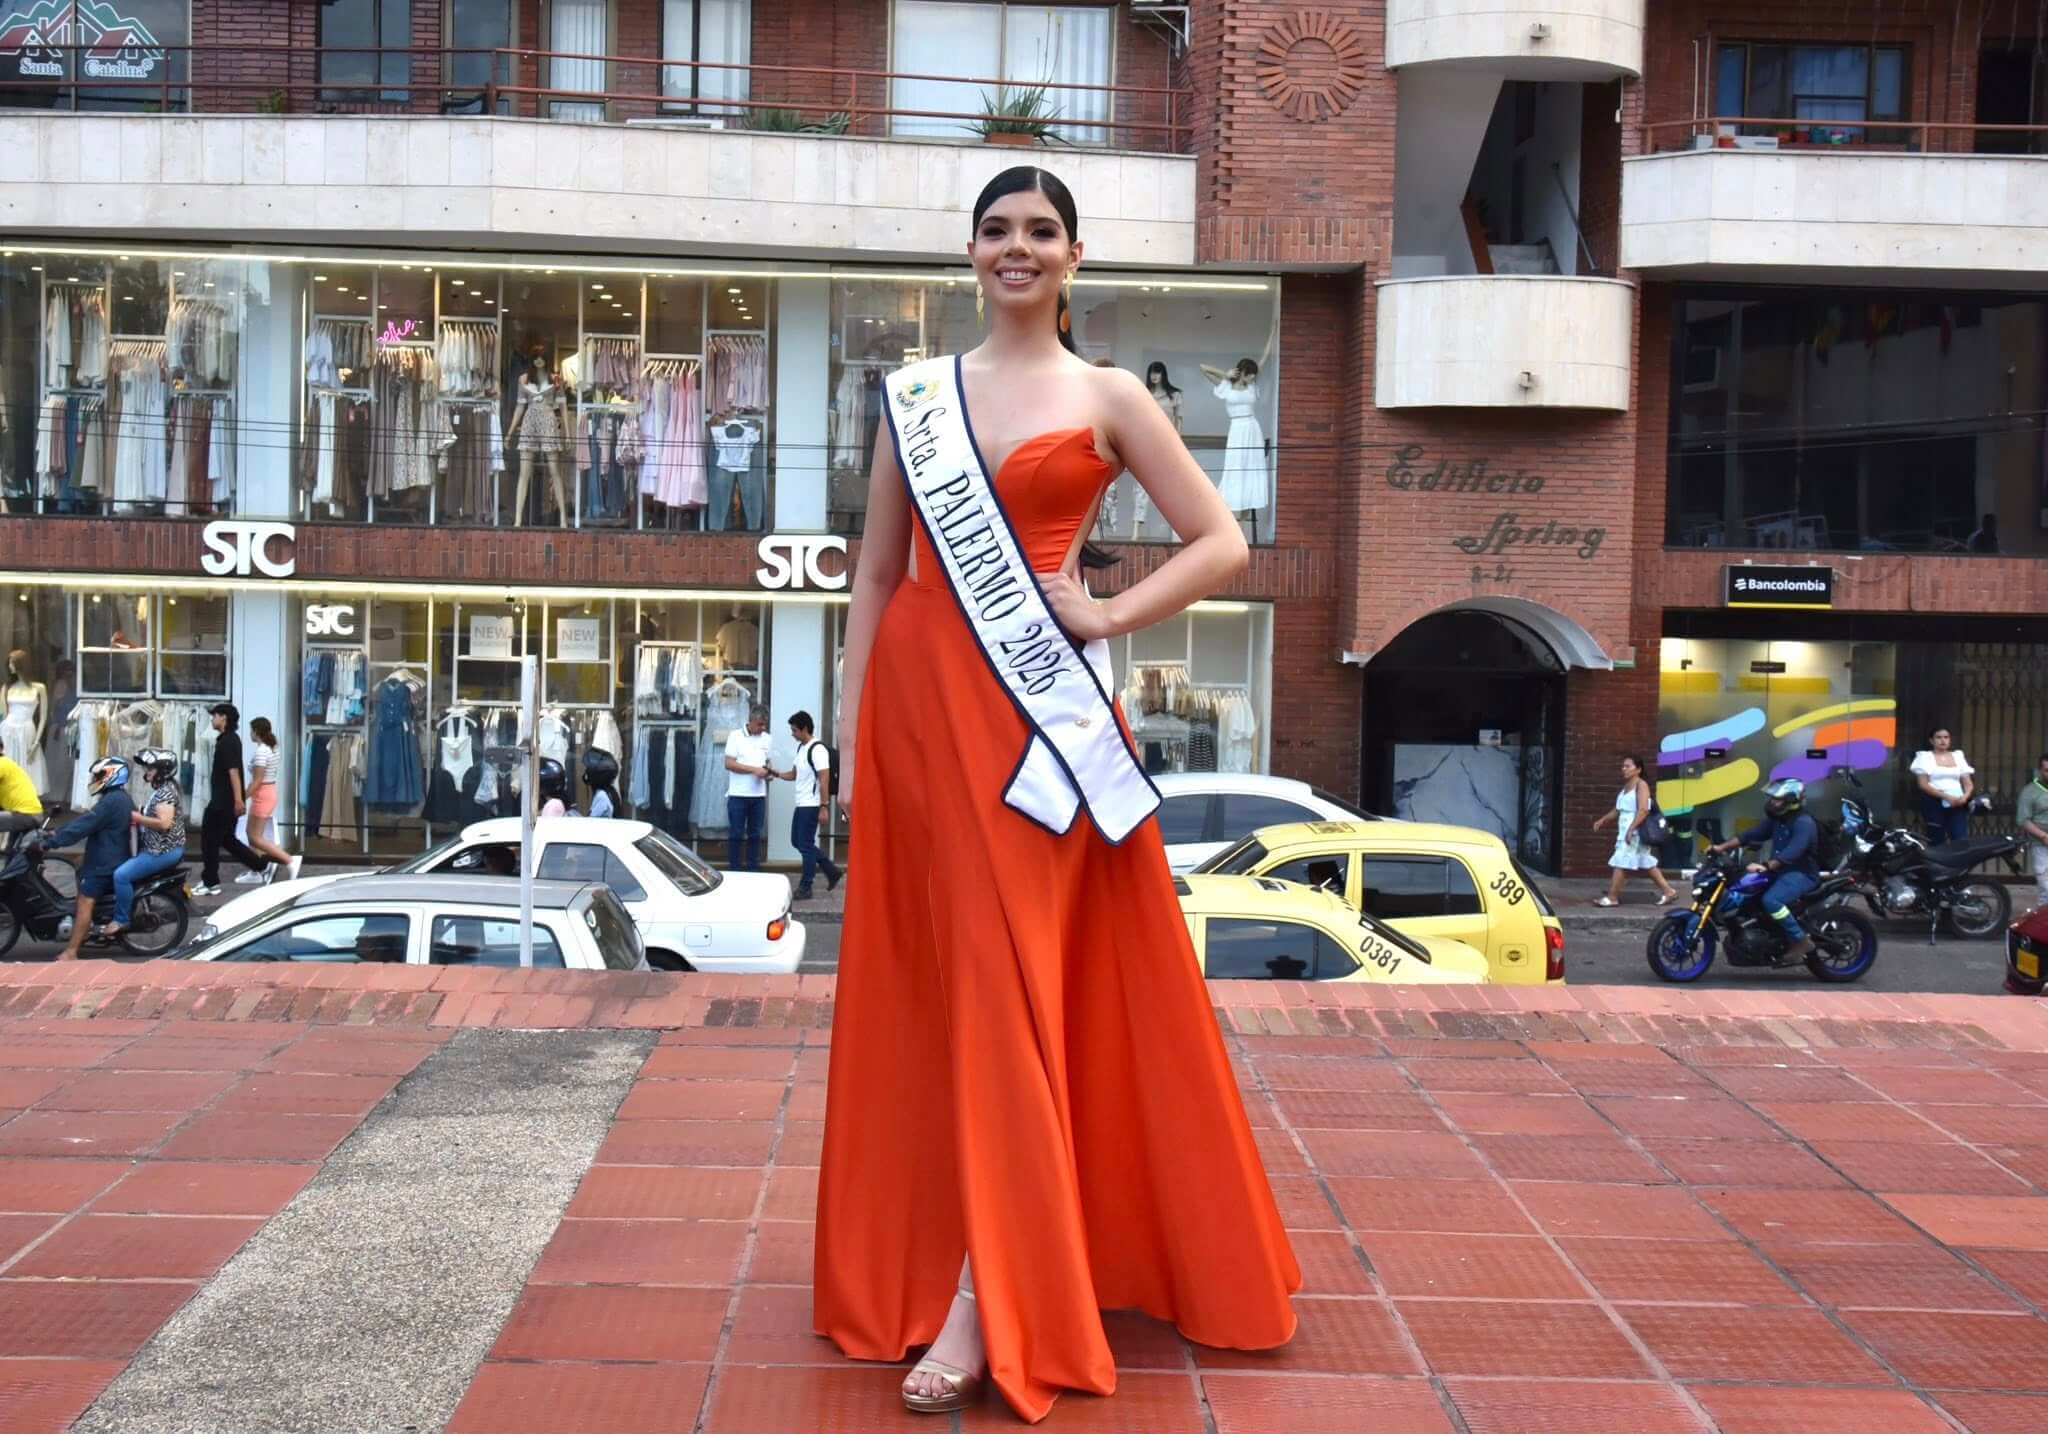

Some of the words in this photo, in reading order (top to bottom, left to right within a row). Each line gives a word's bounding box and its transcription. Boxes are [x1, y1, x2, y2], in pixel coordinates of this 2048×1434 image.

[20, 57, 63, 76] Santa
[904, 408, 946, 477] Srta.
[1386, 444, 1545, 492] Edificio
[201, 520, 295, 578] STC
[923, 470, 1026, 622] PALERMO
[1453, 512, 1606, 559] Spring
[756, 534, 847, 590] STC
[1748, 579, 1827, 591] Bancolombia
[306, 604, 354, 635] STC
[474, 626, 509, 639] NEW
[562, 629, 597, 642] NEW
[1000, 624, 1071, 695] 2026
[1490, 872, 1525, 906] 389
[1360, 935, 1402, 975] 0381
